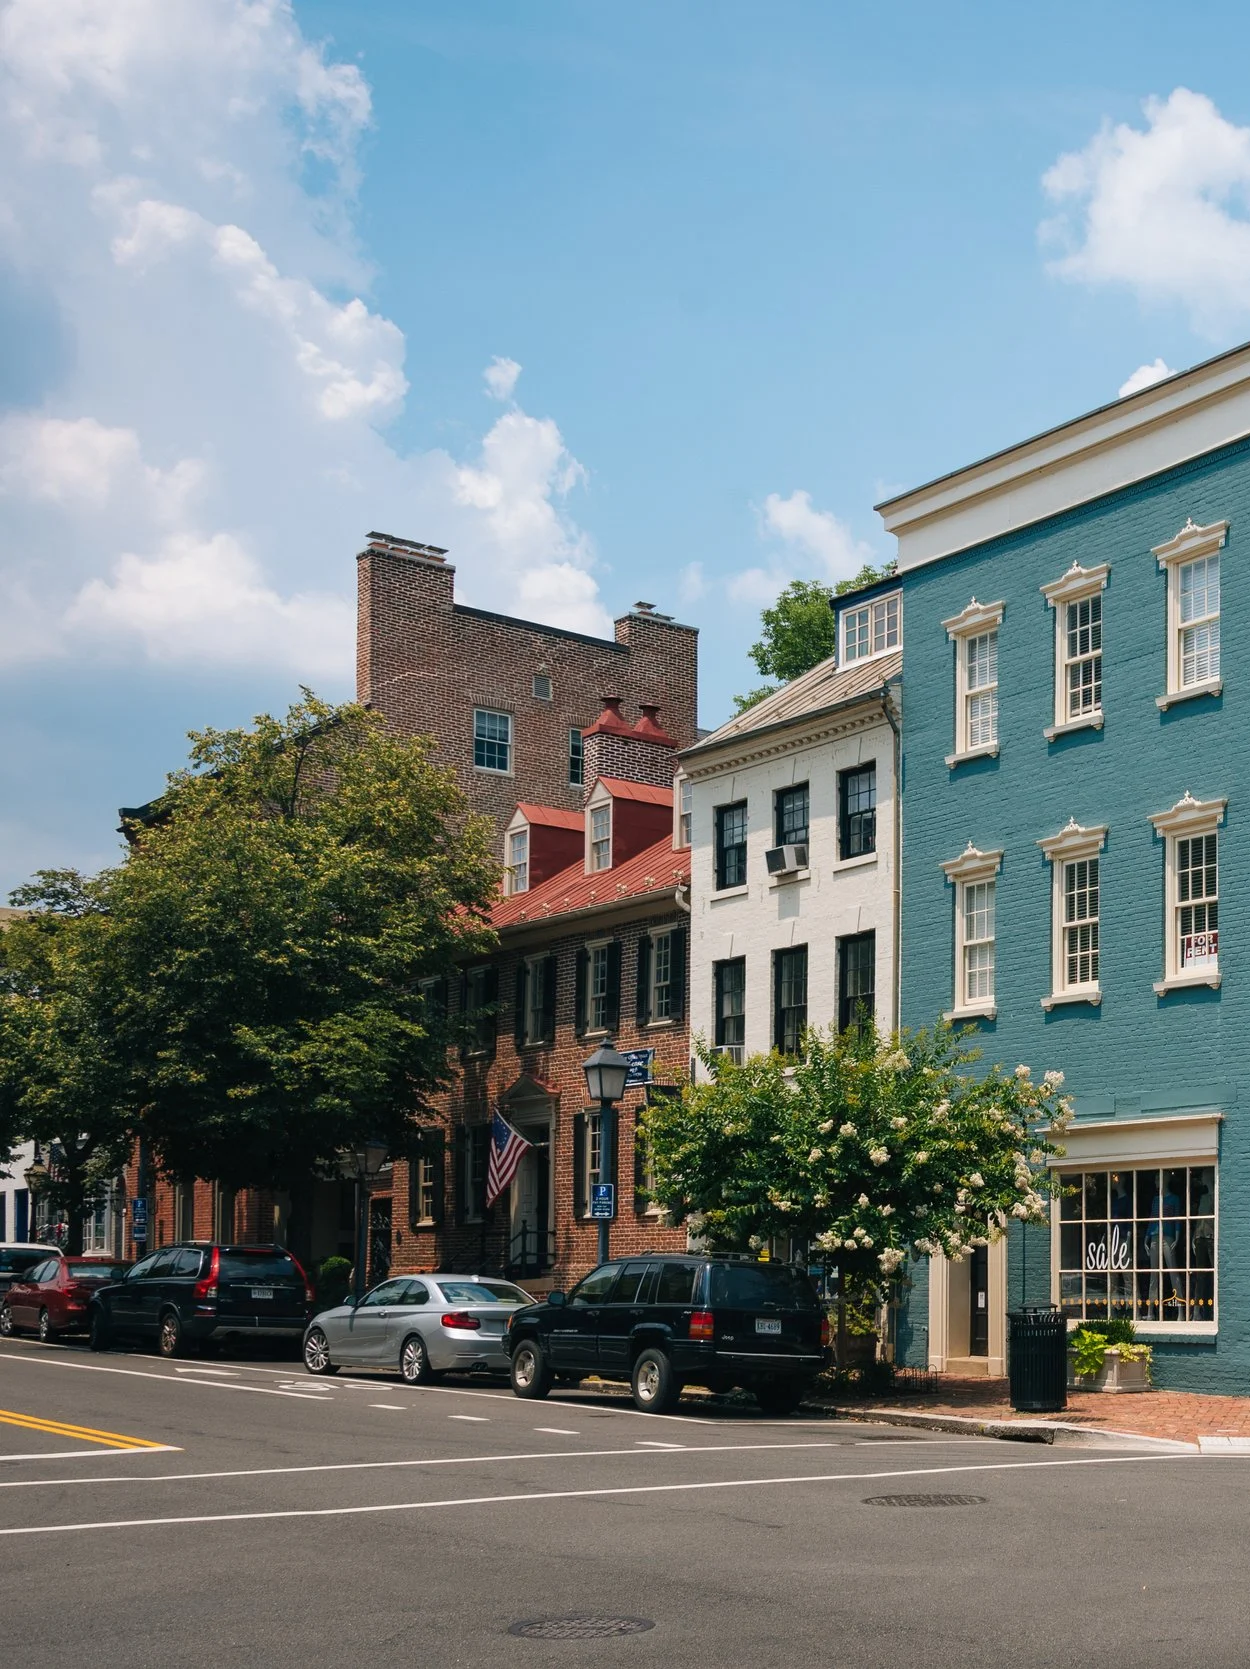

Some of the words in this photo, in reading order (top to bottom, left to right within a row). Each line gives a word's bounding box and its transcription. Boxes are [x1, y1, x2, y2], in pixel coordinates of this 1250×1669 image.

[1191, 934, 1213, 946] FOR
[1187, 943, 1217, 957] RENT
[600, 1187, 606, 1196] P
[1086, 1224, 1130, 1270] sale
